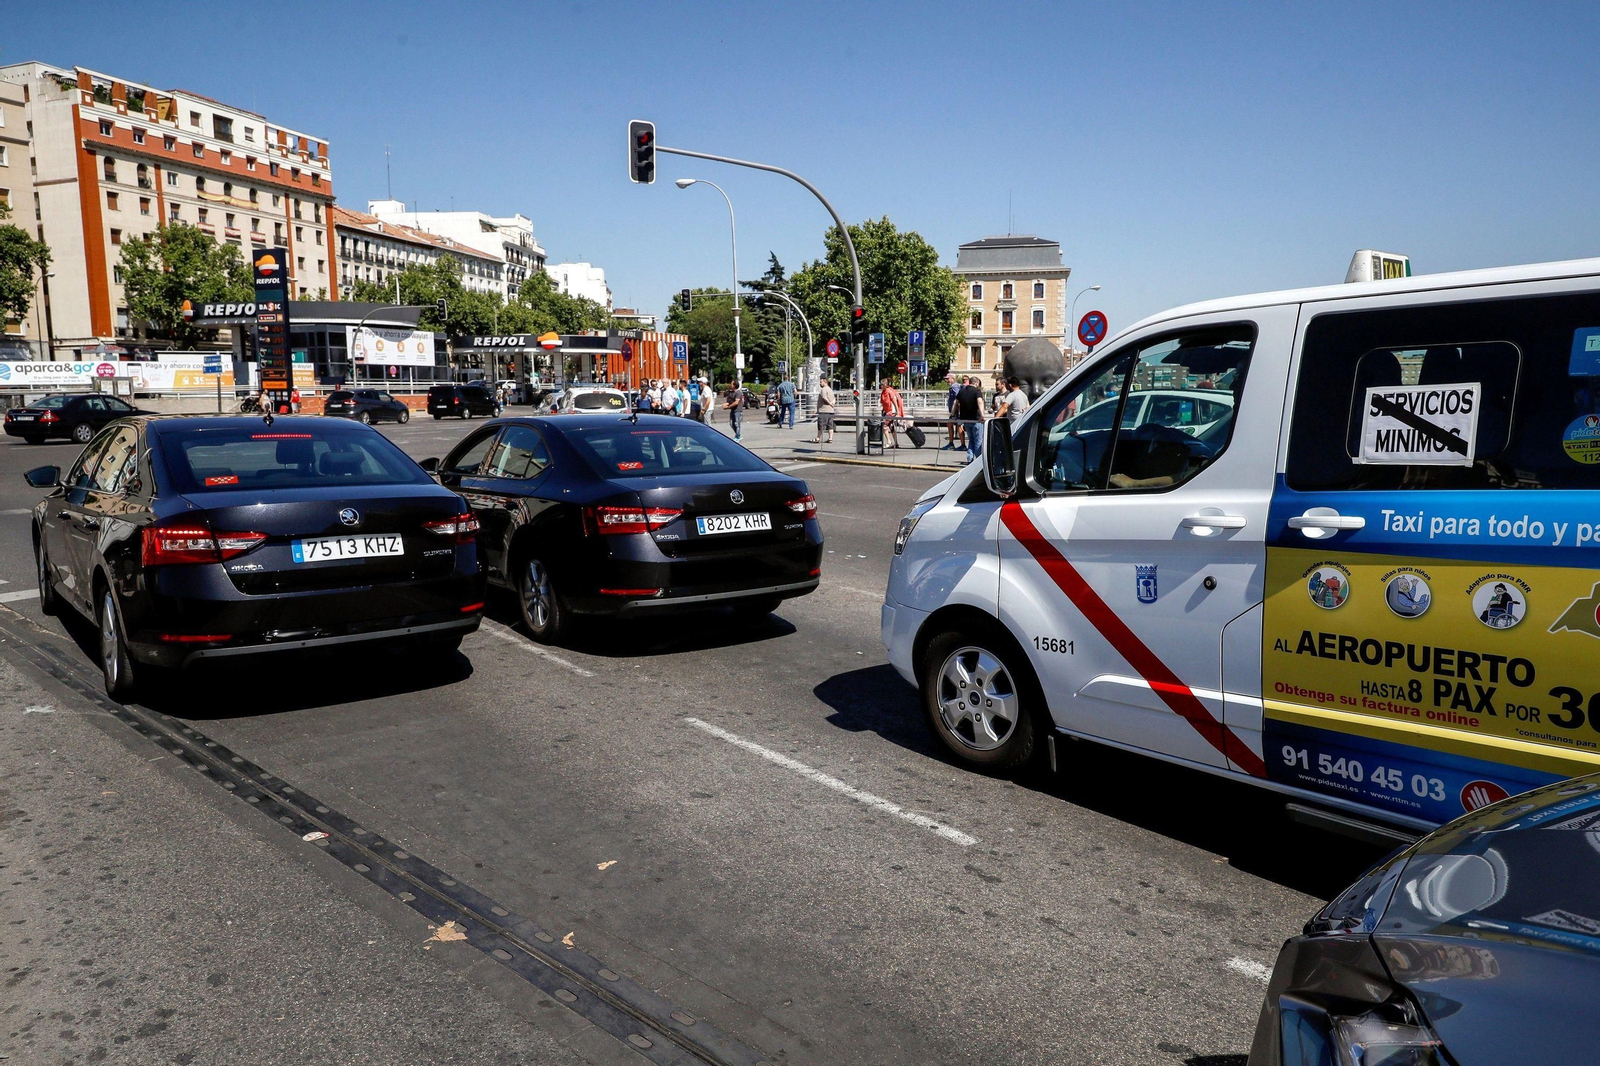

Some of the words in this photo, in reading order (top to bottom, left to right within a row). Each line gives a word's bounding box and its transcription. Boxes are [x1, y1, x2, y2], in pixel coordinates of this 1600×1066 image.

[1384, 262, 1404, 279] TAXI
[204, 303, 256, 316] REPSO
[258, 303, 281, 311] BASIC
[473, 336, 526, 346] REPSOL
[617, 330, 636, 338] REPSOL
[914, 332, 920, 342] P
[677, 344, 685, 357] P
[15, 362, 95, 375] aparca&go
[145, 362, 163, 370] Paga
[706, 515, 741, 532] 8202
[745, 513, 769, 529] KHR
[1381, 509, 1424, 533] Taxi
[1429, 516, 1480, 539] para
[1488, 514, 1545, 539] todo
[1552, 522, 1568, 546] y
[307, 538, 358, 559] 7513
[364, 536, 400, 554] KHZ
[1397, 566, 1413, 574] para
[1465, 573, 1496, 595] Adaptado
[1497, 573, 1515, 581] para
[1515, 578, 1532, 593] PMR
[1033, 636, 1074, 655] 15681
[1274, 638, 1292, 653] AL
[1296, 630, 1536, 688] AEROPUERTO
[1274, 681, 1335, 703] Obtenga
[1340, 695, 1357, 706] su
[1362, 696, 1421, 717] factura
[1425, 709, 1480, 728] online
[1361, 680, 1407, 701] HASTA
[1408, 679, 1423, 703] 8
[1433, 678, 1498, 716] PAX
[1505, 703, 1541, 724] POR
[1576, 739, 1597, 748] para
[1281, 745, 1309, 770] 91
[1318, 753, 1364, 782] 540
[1370, 766, 1404, 792] 45
[1411, 774, 1447, 801] 03
[1298, 773, 1359, 793] www.pidetaxi.es
